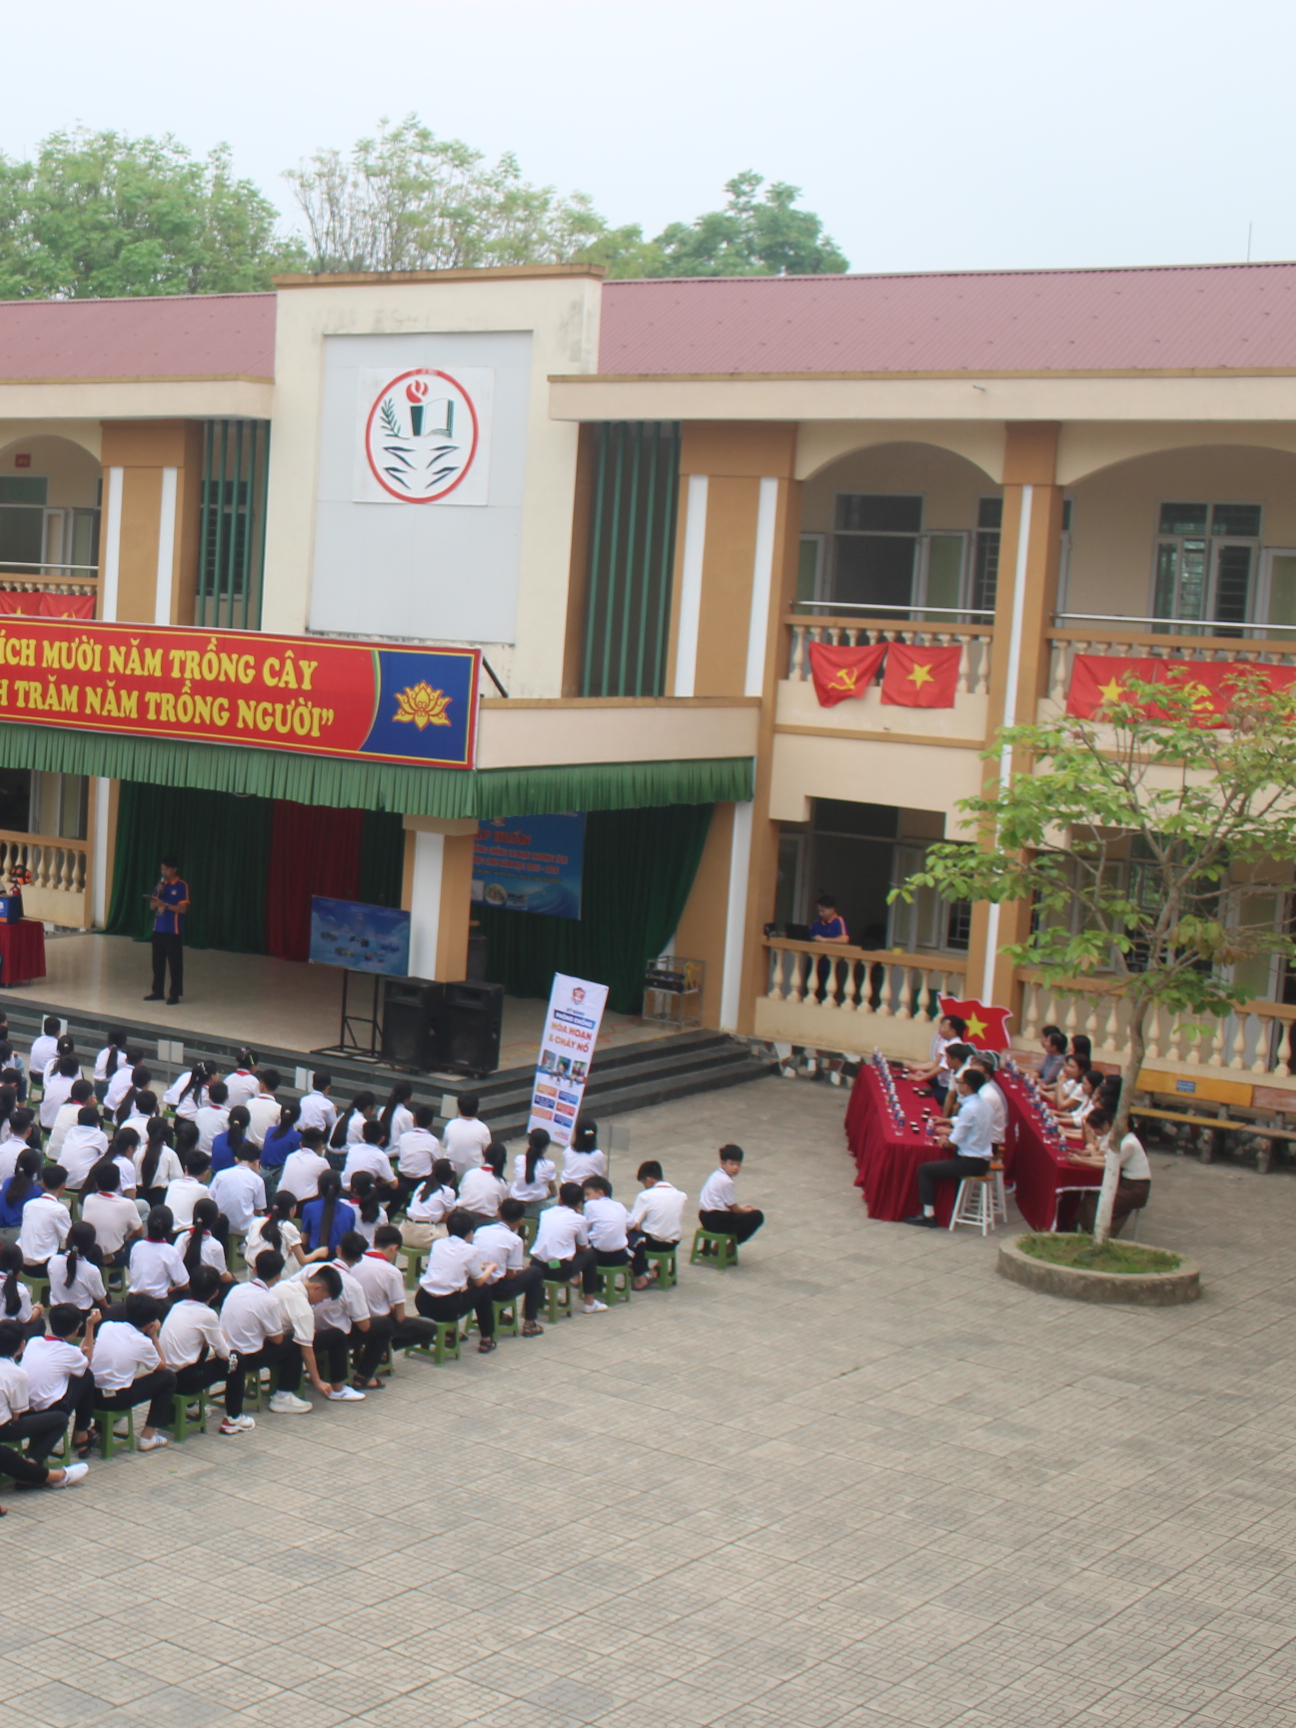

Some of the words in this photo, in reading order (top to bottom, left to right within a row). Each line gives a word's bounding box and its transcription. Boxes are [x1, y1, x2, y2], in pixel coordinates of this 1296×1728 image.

[42, 635, 102, 672] MƯỜI
[108, 637, 163, 677] NĂM
[169, 637, 255, 684] TRỒNG
[263, 650, 318, 690] CÂY
[14, 674, 79, 713] TRĂM
[85, 679, 139, 718] NĂM
[145, 680, 230, 726] TRỒNG
[237, 697, 334, 737] NGƯỜI”
